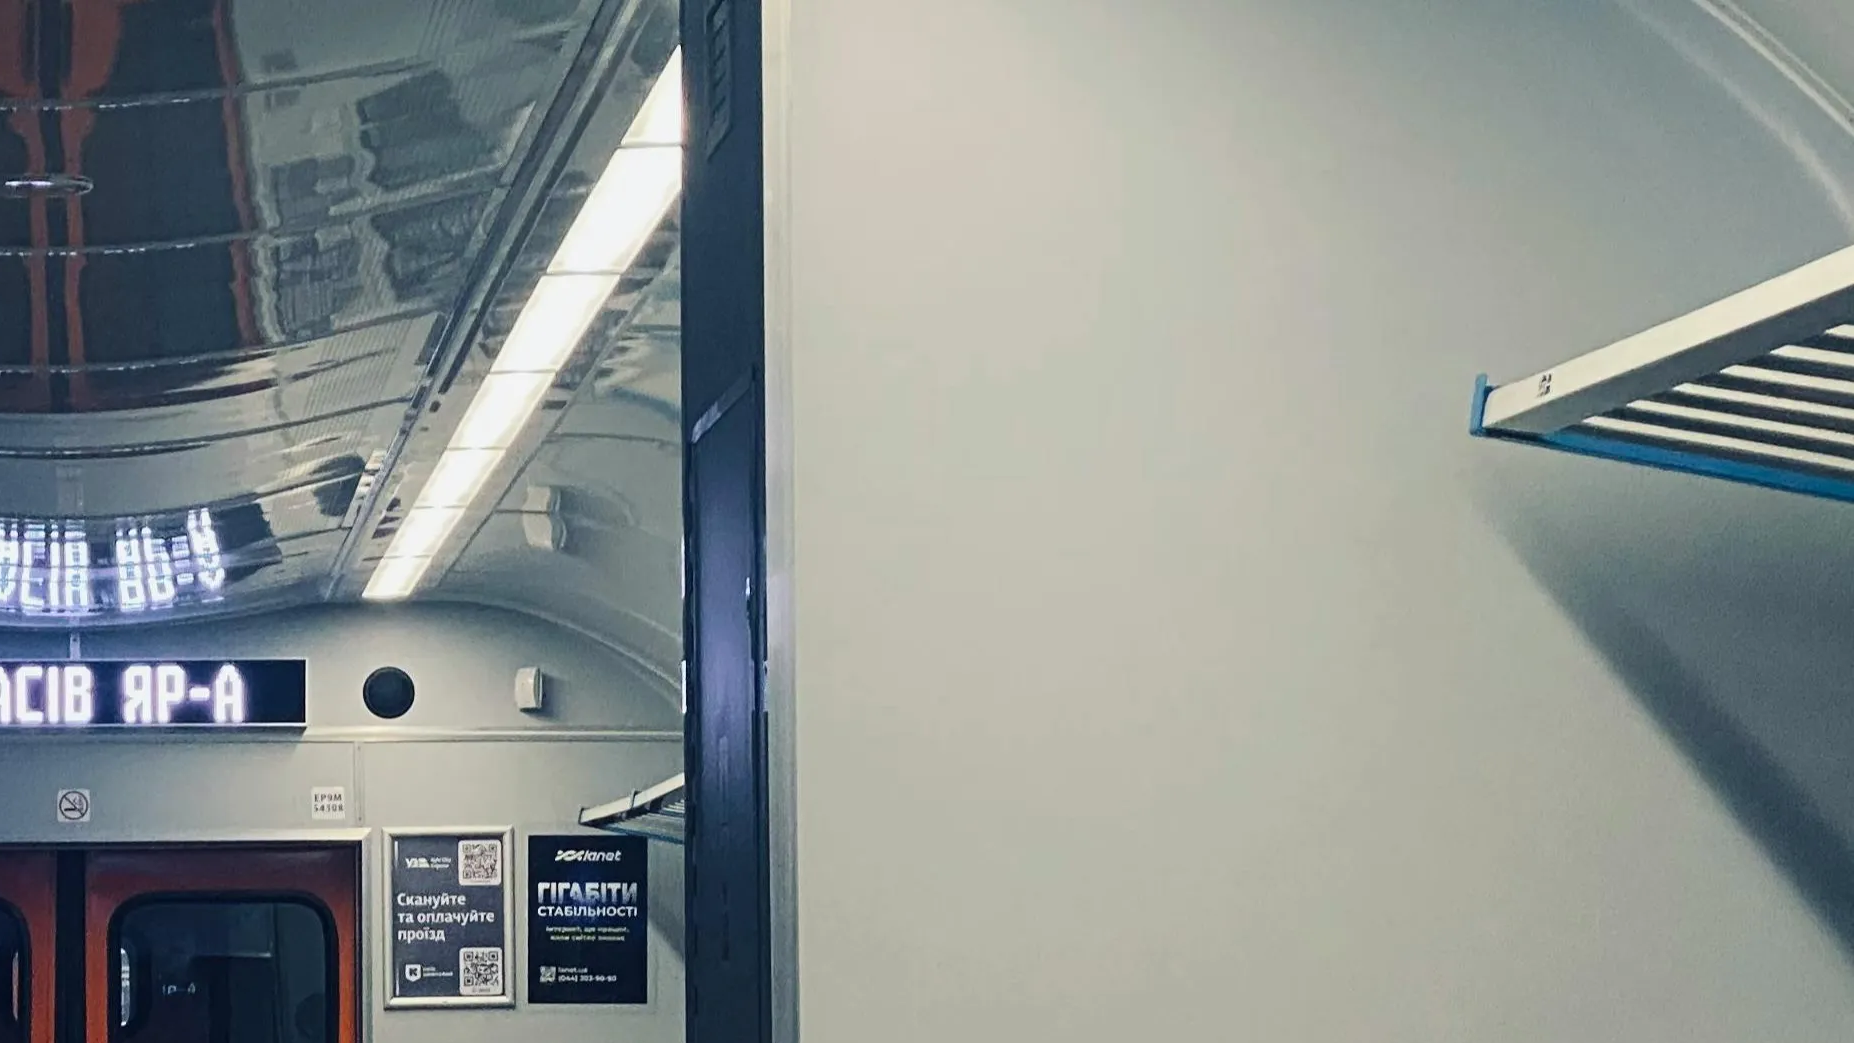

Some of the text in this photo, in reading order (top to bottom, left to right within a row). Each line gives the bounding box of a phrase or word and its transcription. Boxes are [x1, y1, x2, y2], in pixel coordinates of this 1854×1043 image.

[122, 664, 244, 725] ЯР-А
[397, 892, 467, 909] Скануйте
[537, 882, 638, 904] ГІГАБІТИ
[398, 910, 495, 926] та оплачуйте
[537, 906, 638, 917] СТАБІЛЬНОСТІ
[398, 928, 446, 943] проїзд
